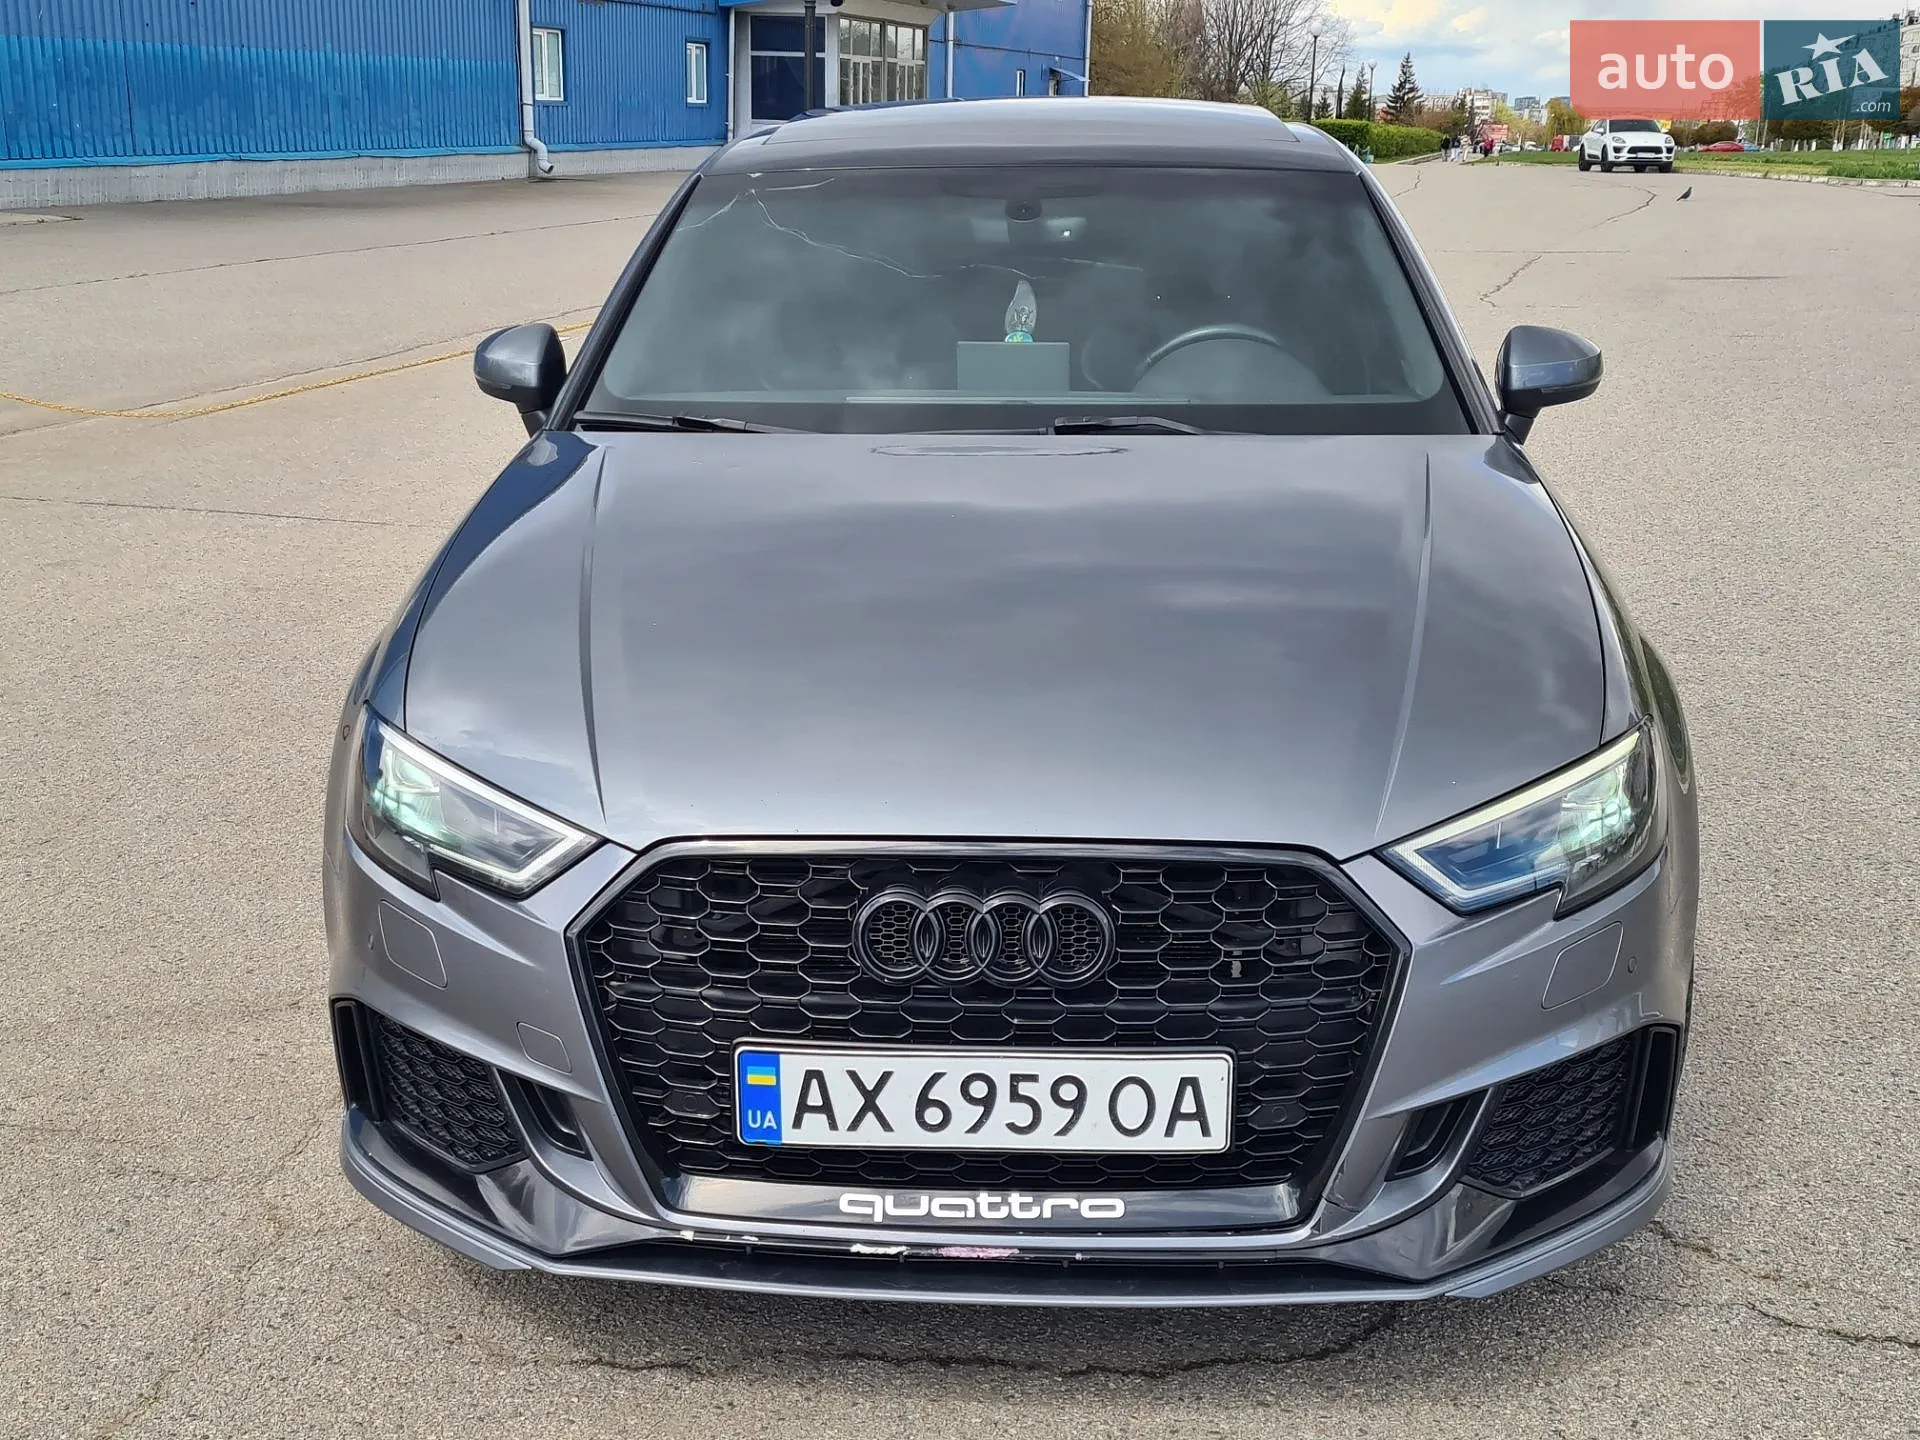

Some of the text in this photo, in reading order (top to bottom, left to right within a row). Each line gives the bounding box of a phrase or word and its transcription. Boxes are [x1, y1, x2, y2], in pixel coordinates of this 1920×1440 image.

[747, 1109, 778, 1130] UA
[791, 1069, 1212, 1138] AX 6959 OA
[839, 1191, 1126, 1223] quattro
